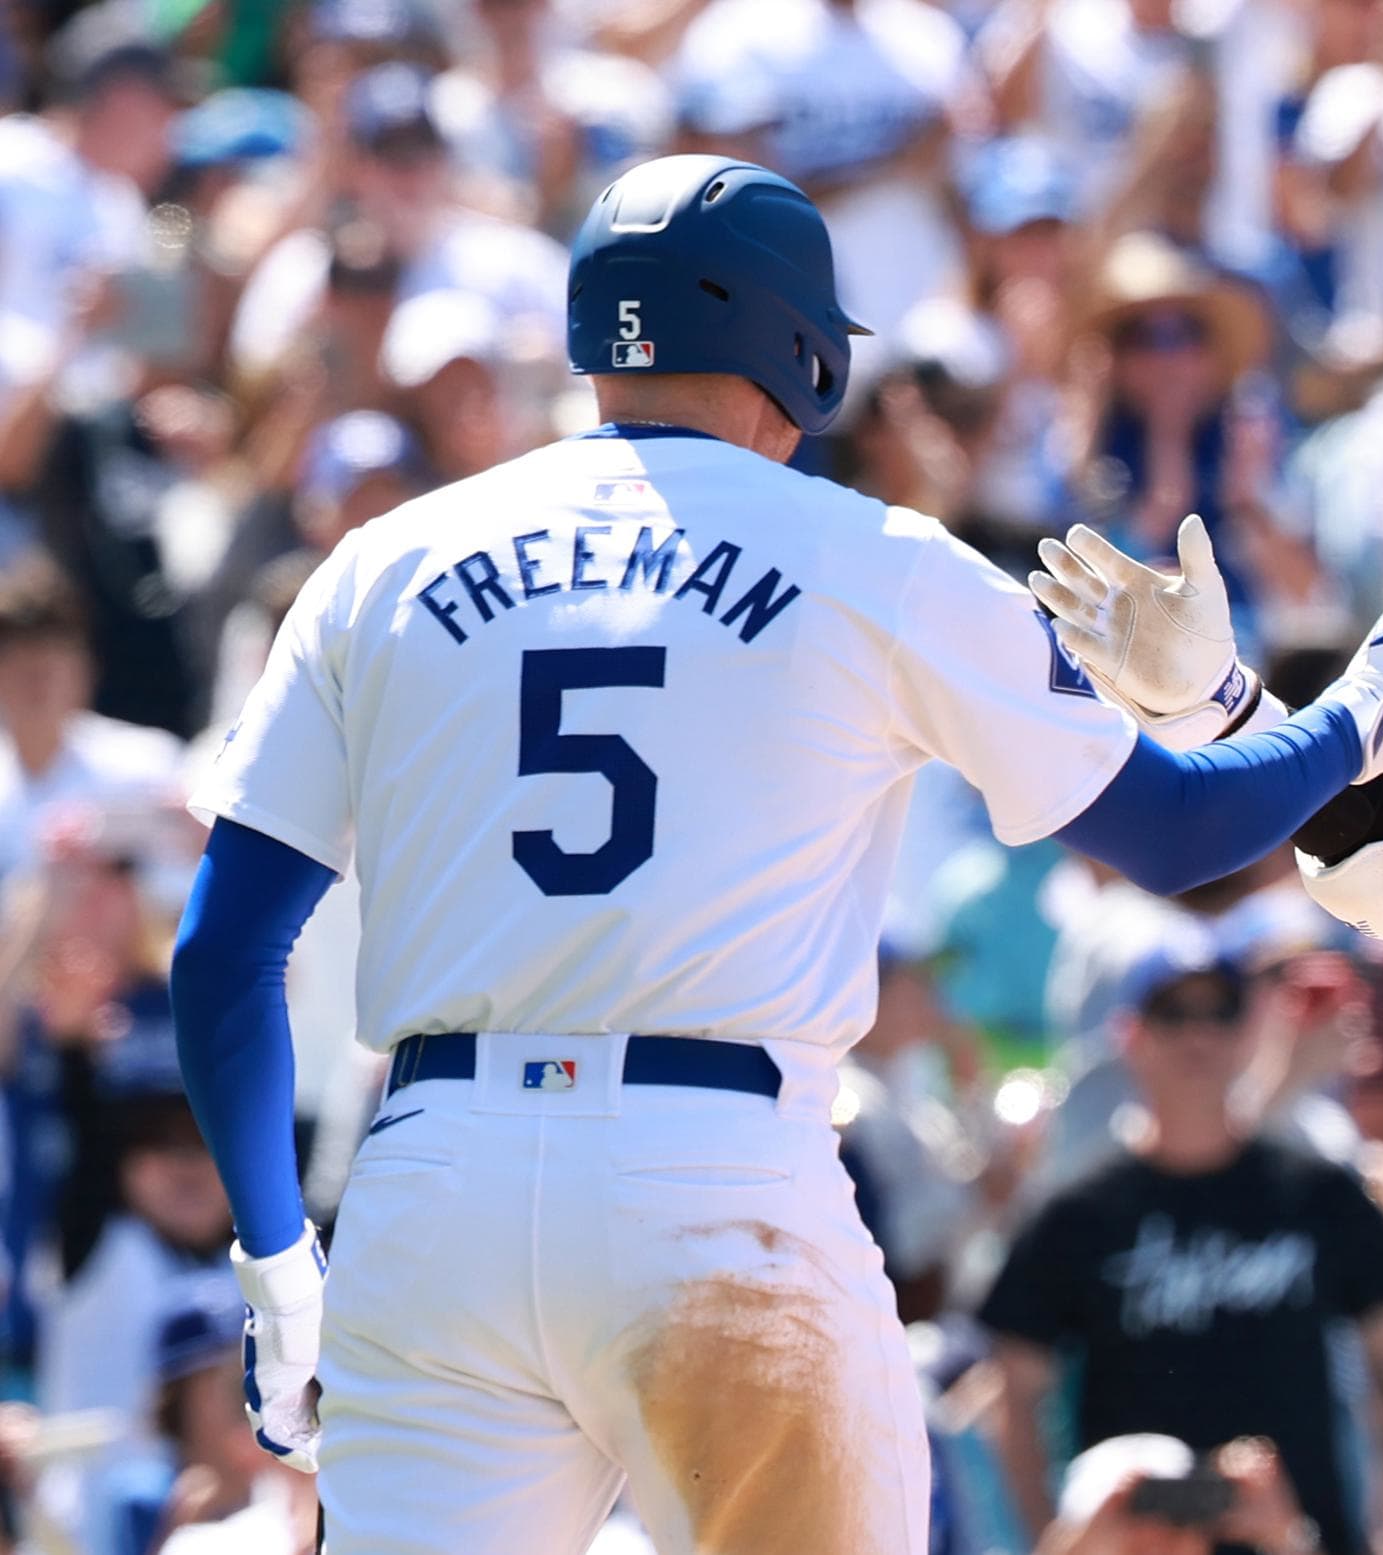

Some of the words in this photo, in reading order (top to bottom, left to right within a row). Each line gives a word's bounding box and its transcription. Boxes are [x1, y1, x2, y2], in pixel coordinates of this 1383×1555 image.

[619, 300, 641, 341] 5
[416, 526, 802, 645] FREEMAN
[512, 646, 667, 896] 5
